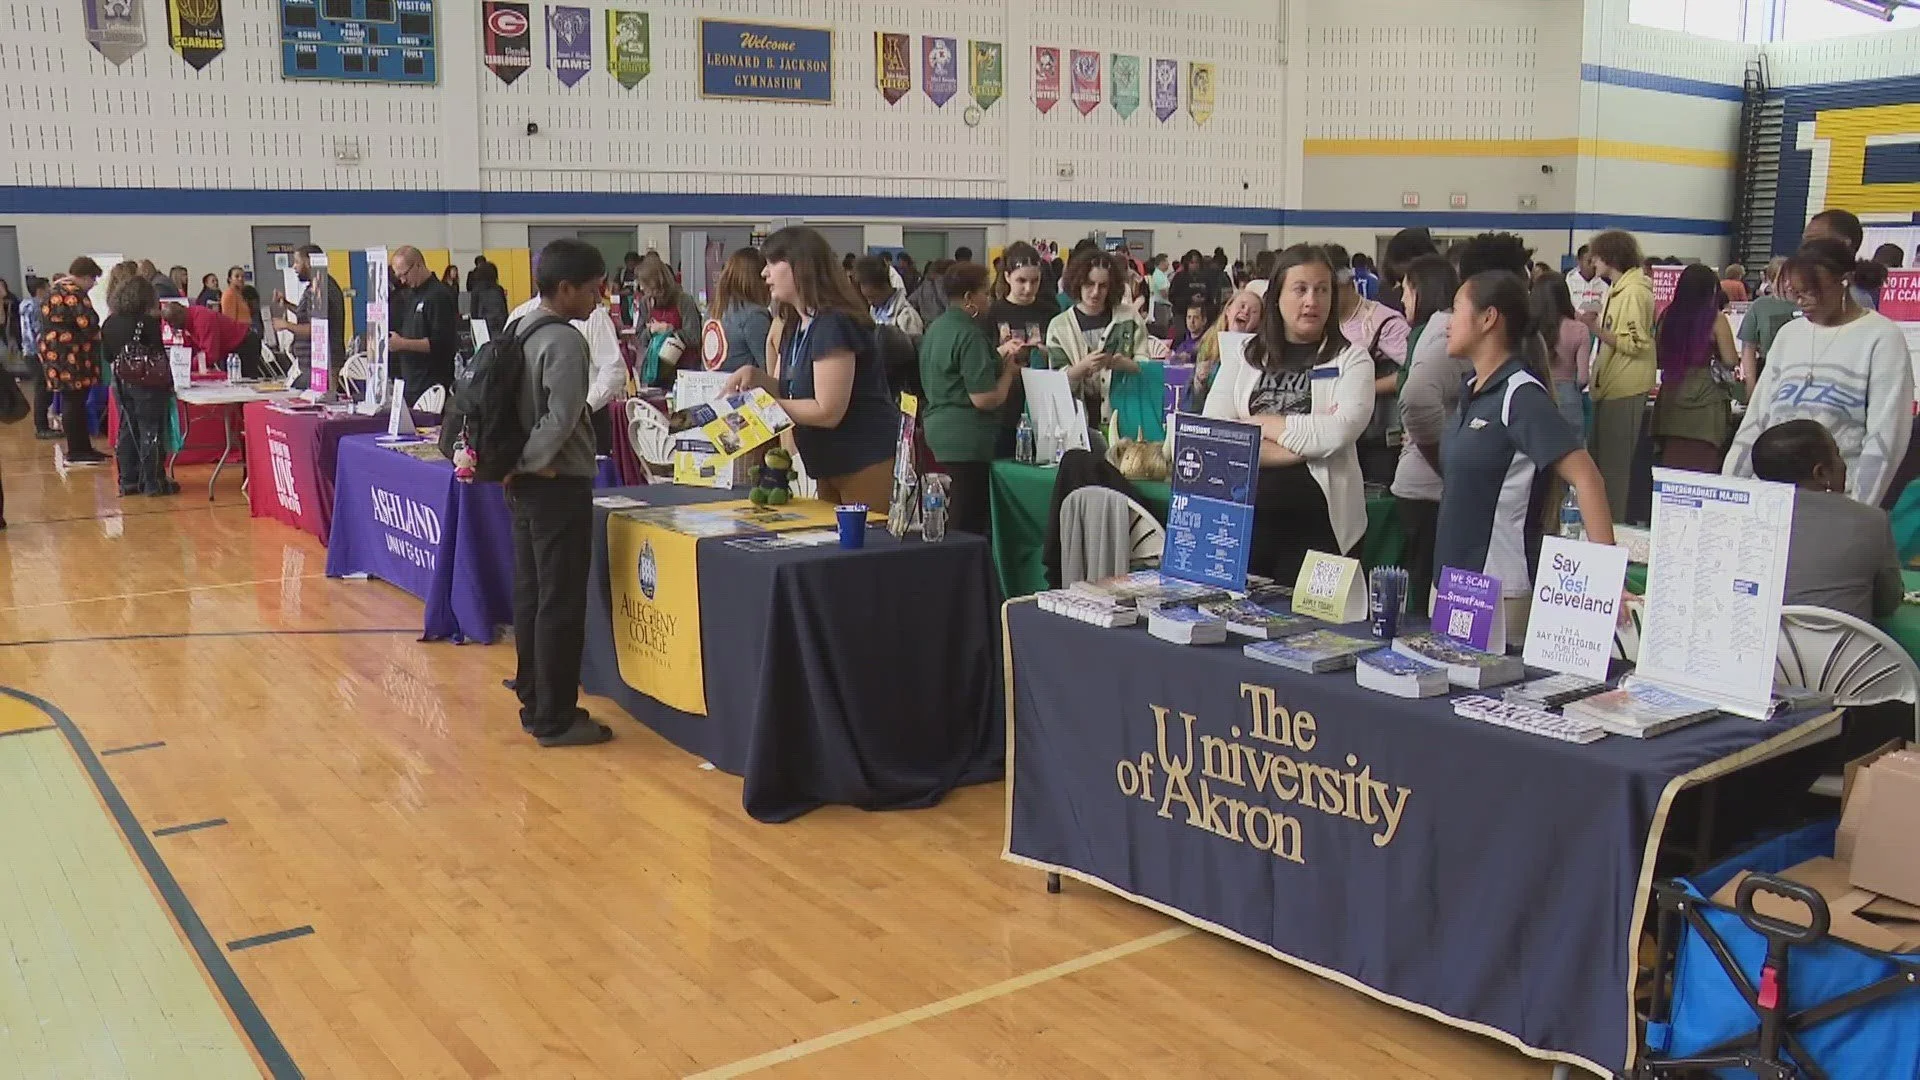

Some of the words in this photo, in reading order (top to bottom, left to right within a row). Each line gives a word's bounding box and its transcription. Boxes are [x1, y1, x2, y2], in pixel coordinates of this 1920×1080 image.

[397, 1, 431, 11] VISITOR
[175, 37, 223, 49] SCARABS
[298, 32, 321, 40] BONUS
[397, 37, 420, 45] BONUS
[740, 31, 796, 51] Welcome
[337, 47, 362, 55] PLAYER
[368, 48, 389, 56] FOULS
[402, 50, 423, 58] FOULS
[707, 52, 760, 69] LEONARD
[780, 58, 828, 73] JACKSON
[734, 73, 801, 90] GYMNASIUM
[1653, 271, 1673, 279] REAL
[1899, 277, 1909, 288] IT
[1883, 290, 1896, 301] AT
[1661, 482, 1719, 500] UNDERGRADUATE
[1719, 491, 1750, 504] MAJORS
[1172, 495, 1188, 510] ZIP
[371, 485, 441, 545] ASHLAND
[1552, 553, 1581, 576] Say
[1450, 572, 1465, 584] WE
[1465, 575, 1490, 589] SCAN
[1558, 573, 1589, 593] Yes!
[1540, 585, 1614, 615] Cleveland
[1536, 630, 1552, 641] SAY
[1553, 633, 1567, 643] YES
[1567, 634, 1602, 653] ELIGIBLE
[1553, 642, 1579, 657] PUBLIC
[1540, 649, 1591, 668] INSTITUTION
[1239, 682, 1317, 752] The
[1148, 703, 1412, 848] University
[1116, 751, 1155, 802] of
[1156, 754, 1305, 865] Akron
